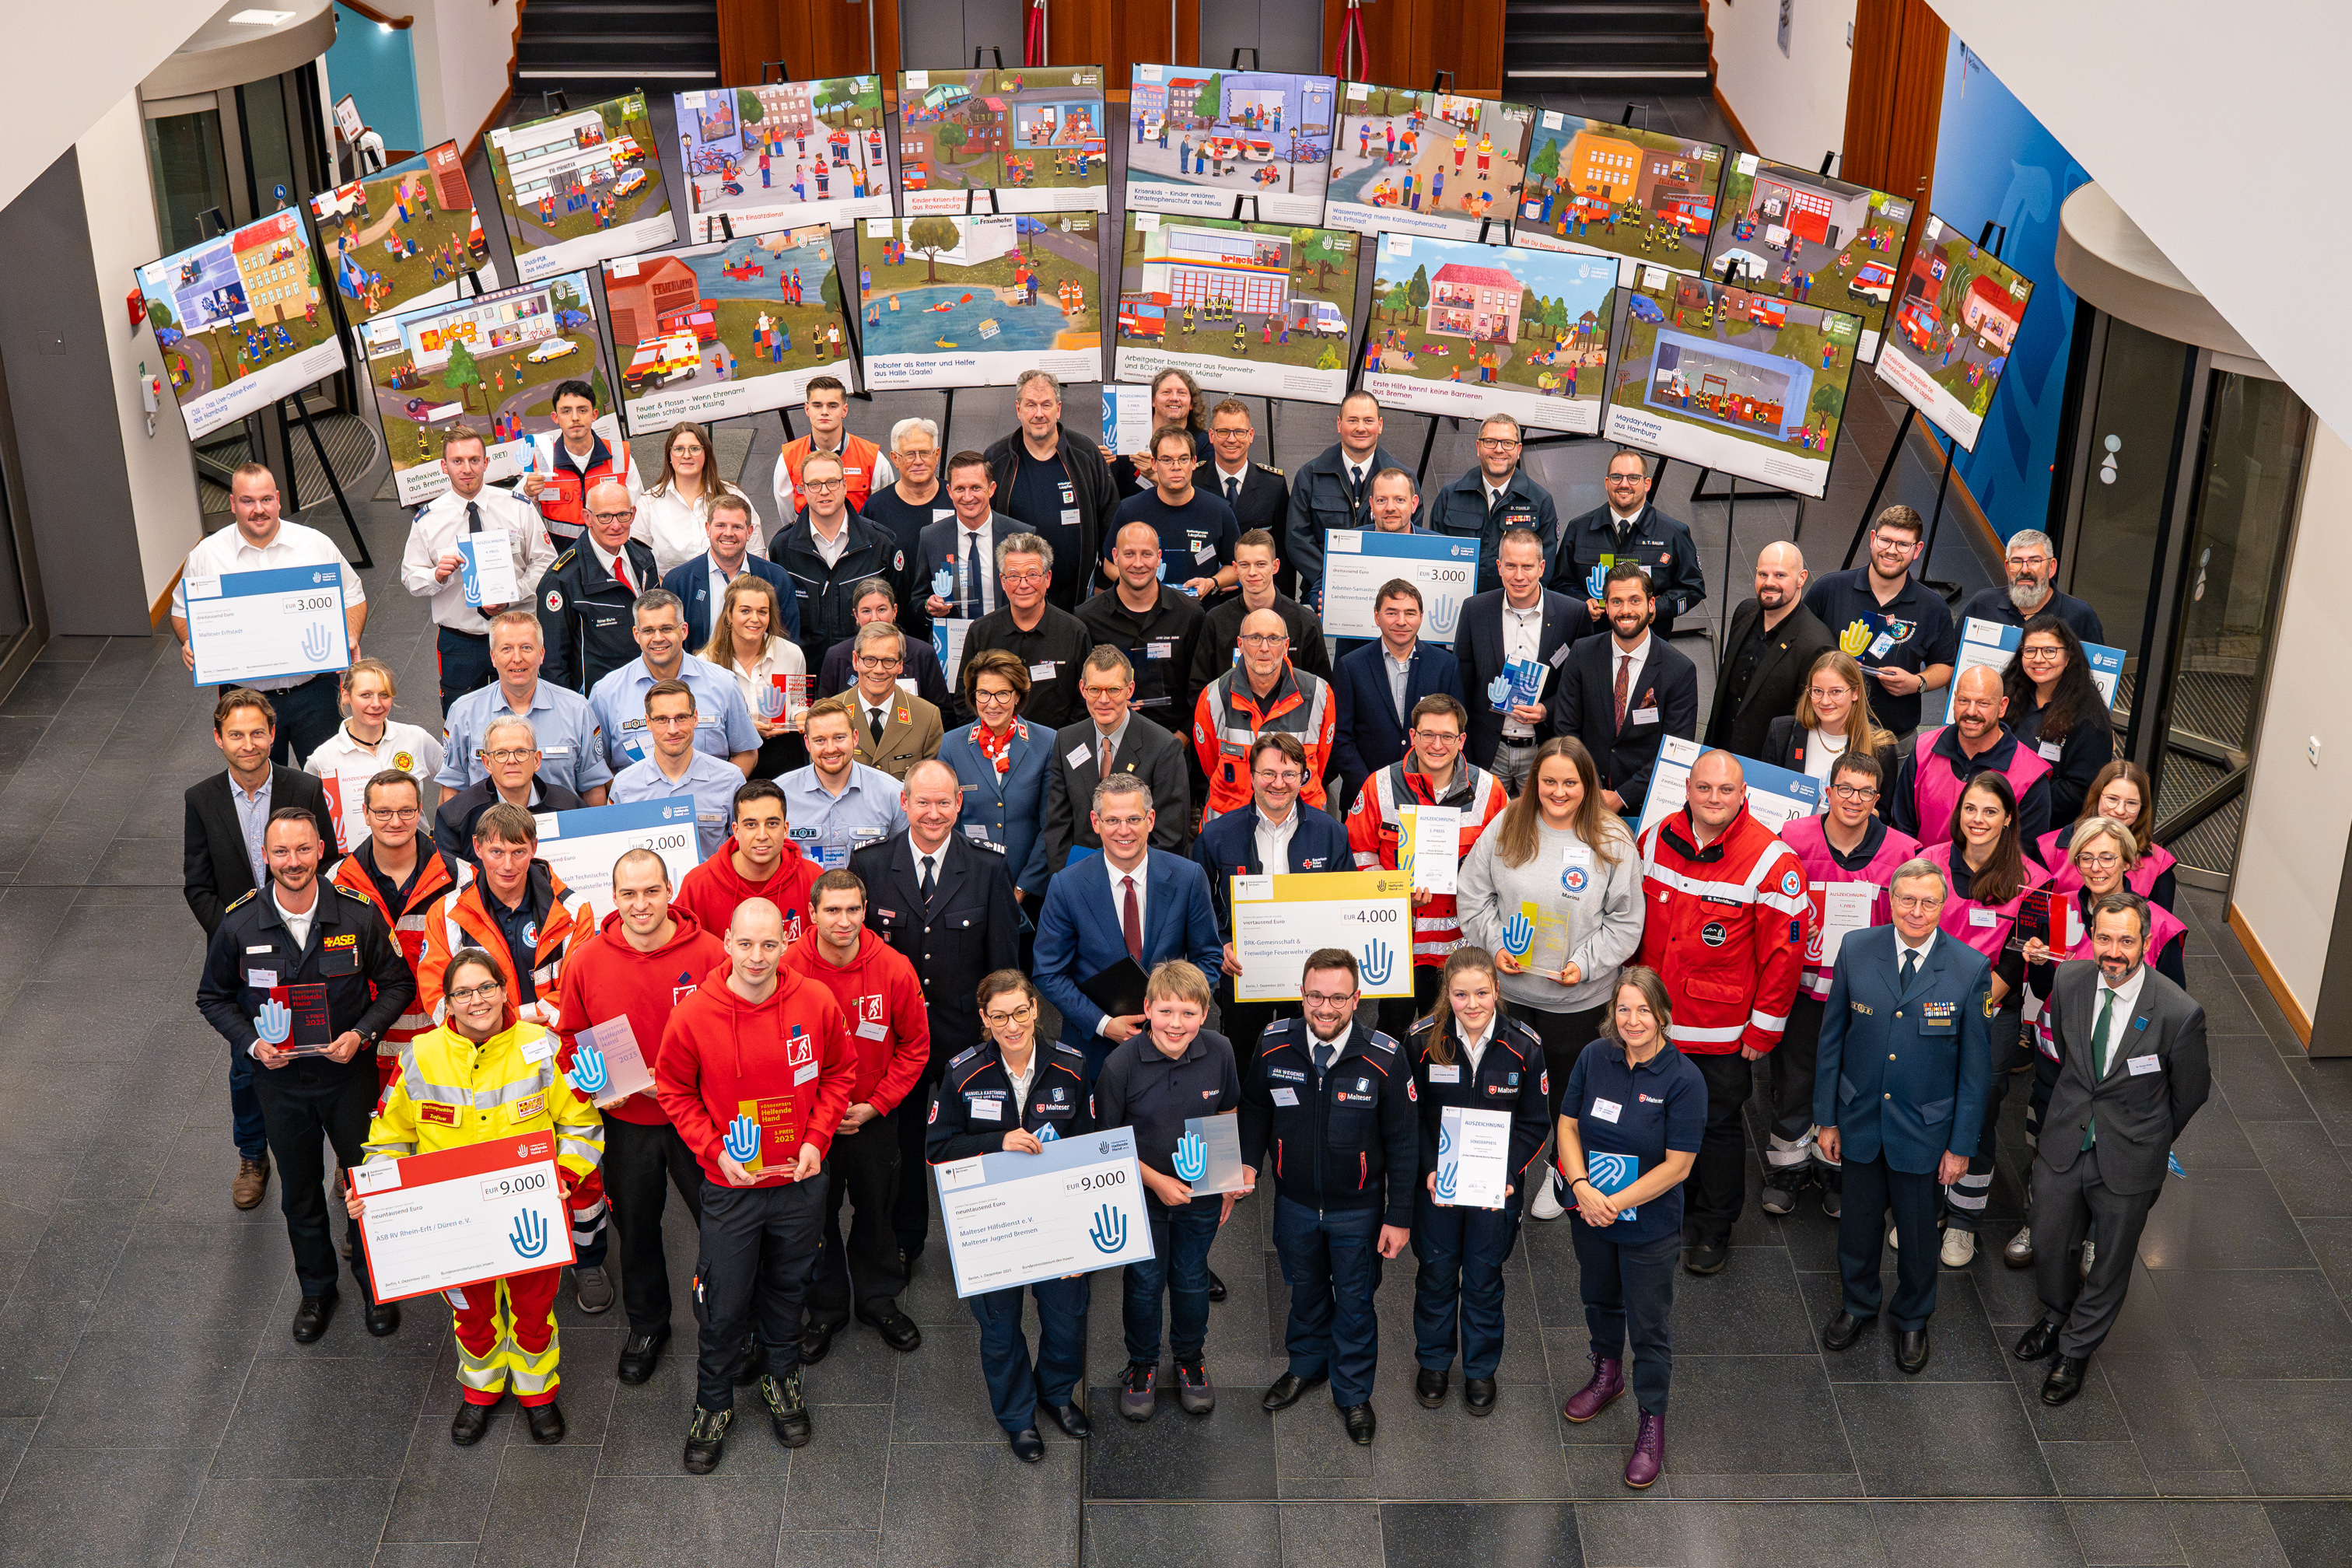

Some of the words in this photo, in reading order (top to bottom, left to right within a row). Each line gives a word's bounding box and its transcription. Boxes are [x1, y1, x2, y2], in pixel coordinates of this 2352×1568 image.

[1134, 194, 1190, 205] Katastrophenschutz
[746, 212, 783, 220] Einsatzdienst
[980, 216, 1012, 225] Fraunhofer
[1332, 207, 1373, 219] Wasserrettung
[1392, 215, 1447, 229] Katastrophenschutz
[1343, 216, 1367, 225] Erftstadt
[1539, 241, 1556, 250] bereit
[526, 265, 535, 274] aus
[536, 260, 556, 271] Münster
[874, 360, 901, 369] Roboter
[1125, 354, 1164, 366] Arbeitgeber
[1167, 359, 1202, 369] bestehend
[1218, 364, 1256, 375] Feuerwehr-
[1195, 369, 1223, 379] Münster
[1373, 380, 1389, 389] Erste
[1391, 381, 1406, 390] Hilfe
[1430, 387, 1448, 396] keine
[1451, 390, 1483, 401] Barrieren
[1386, 390, 1412, 400] Bremen
[636, 403, 656, 412] Feuer
[664, 398, 684, 408] Flosse
[692, 392, 712, 402] Wenn
[713, 387, 745, 399] Ehrenamt
[204, 404, 228, 419] Hamburg
[637, 410, 660, 421] Wellen
[662, 405, 687, 417] schlägt
[688, 404, 701, 412] aus
[702, 398, 725, 409] Kissing
[1615, 413, 1661, 432] Mayday-Arena
[1627, 424, 1657, 439] Hamburg
[407, 469, 440, 484] Reflexives
[408, 481, 422, 492] aus
[1431, 569, 1466, 583] 3.000
[297, 596, 333, 611] 3.000
[1749, 803, 1783, 818] AUSZEICHNUNG
[645, 835, 686, 851] 2.000
[575, 870, 609, 880] Technisches
[1561, 892, 1580, 901] Marina
[1356, 908, 1397, 923] 4.000
[334, 934, 355, 947] ASB
[1347, 1093, 1371, 1101] Malteser
[761, 1106, 793, 1116] Helfende
[761, 1114, 780, 1123] Hand
[1465, 1119, 1505, 1129] AUSZEICHNUNG
[775, 1134, 794, 1143] 2025
[485, 1186, 499, 1195] EUR
[500, 1174, 545, 1195] 9.000
[1066, 1182, 1080, 1191] EUR
[1080, 1170, 1125, 1192] 9.000
[371, 1208, 408, 1220] neuntausend
[955, 1202, 992, 1216] neuntausend
[376, 1233, 388, 1242] ASB
[390, 1231, 398, 1240] RV
[400, 1224, 432, 1238] Rhein-Erft
[436, 1220, 457, 1231] Düren
[960, 1227, 986, 1237] Malteser
[987, 1219, 1019, 1232] Hilfsdienst
[961, 1237, 988, 1248] Malteser
[990, 1232, 1011, 1244] Jugend
[1013, 1226, 1038, 1236] Bremen
